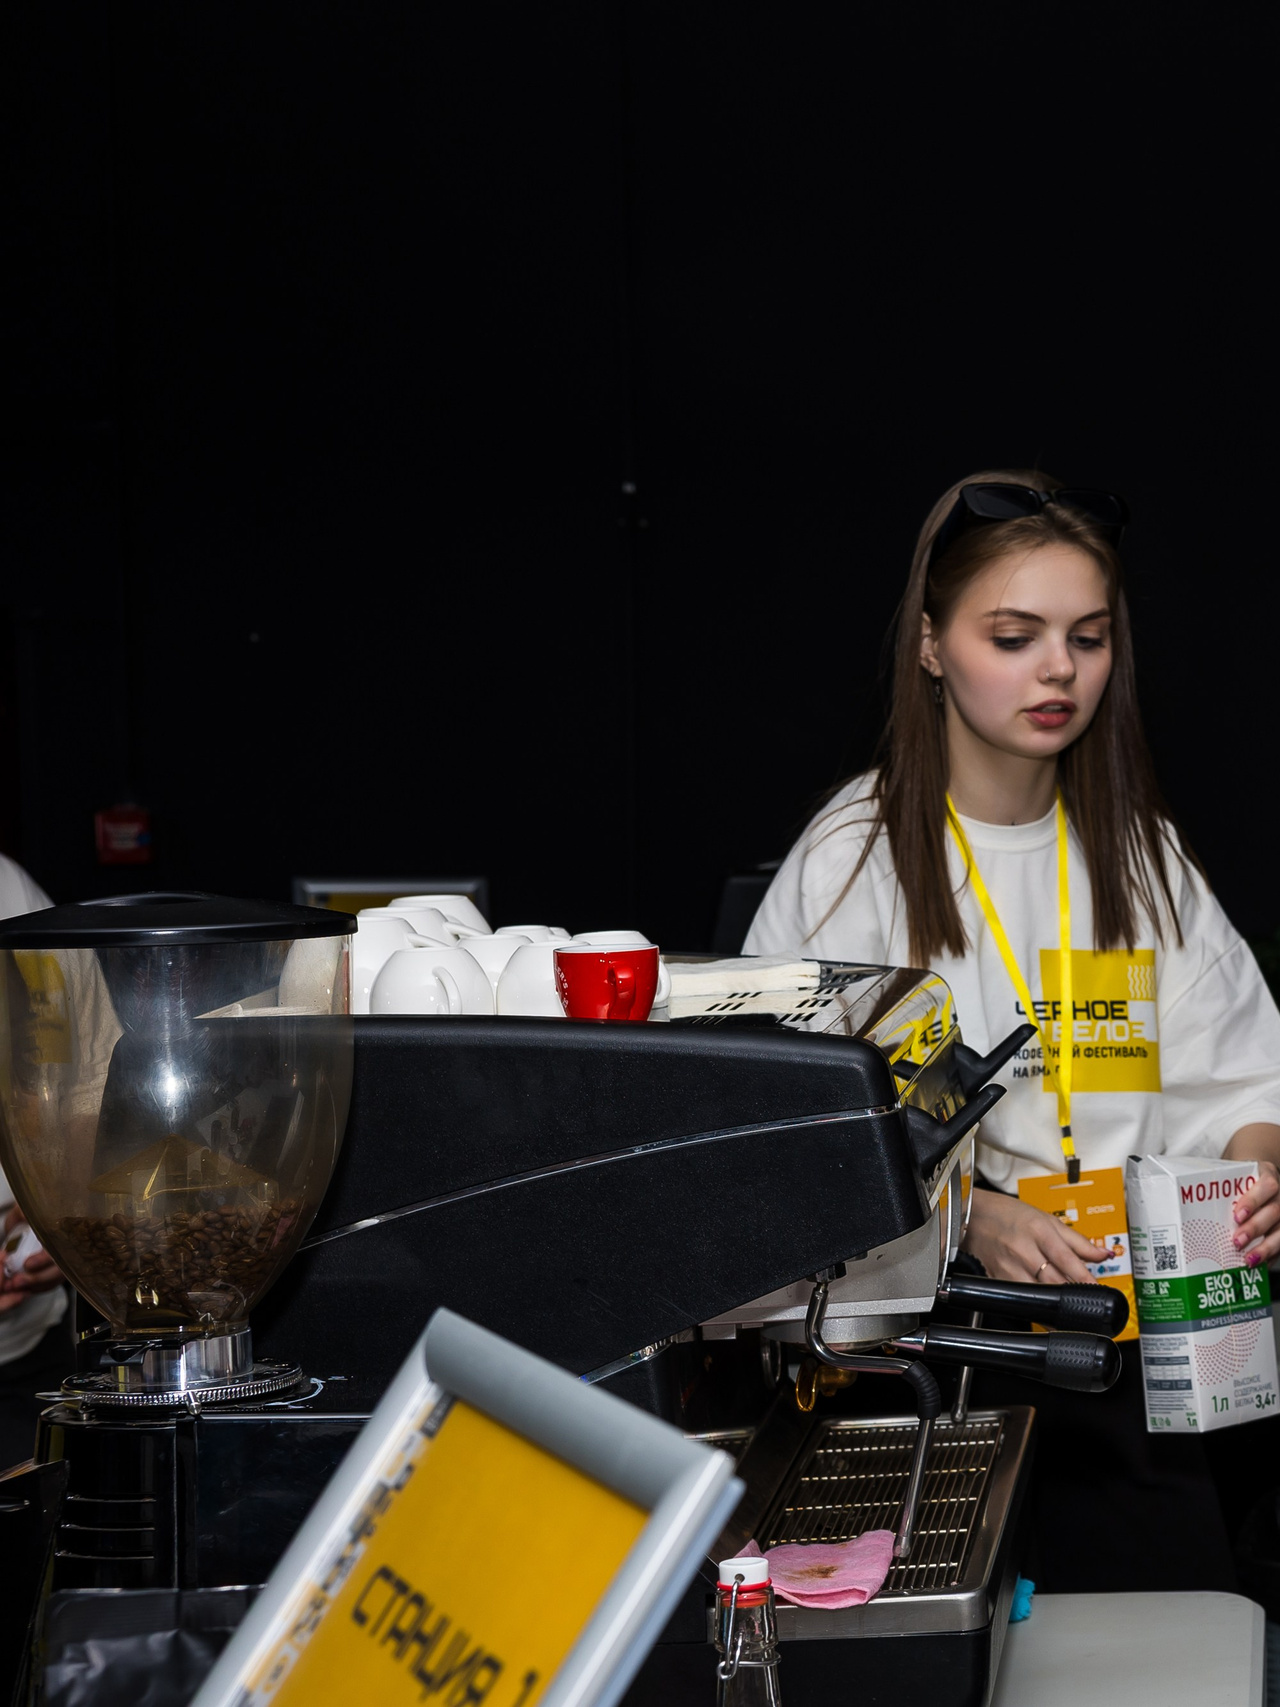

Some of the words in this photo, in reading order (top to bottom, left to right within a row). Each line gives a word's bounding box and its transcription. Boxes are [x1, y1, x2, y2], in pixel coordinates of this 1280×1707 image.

[1083, 1045, 1148, 1058] ФЕСТИВАЛЬ
[1013, 1066, 1029, 1079] НА
[1180, 1175, 1256, 1204] МОЛОКО
[1200, 1312, 1252, 1328] PROFESSIONAL
[1252, 1308, 1268, 1319] LINE
[352, 1562, 505, 1707] СТАНЦИЯ
